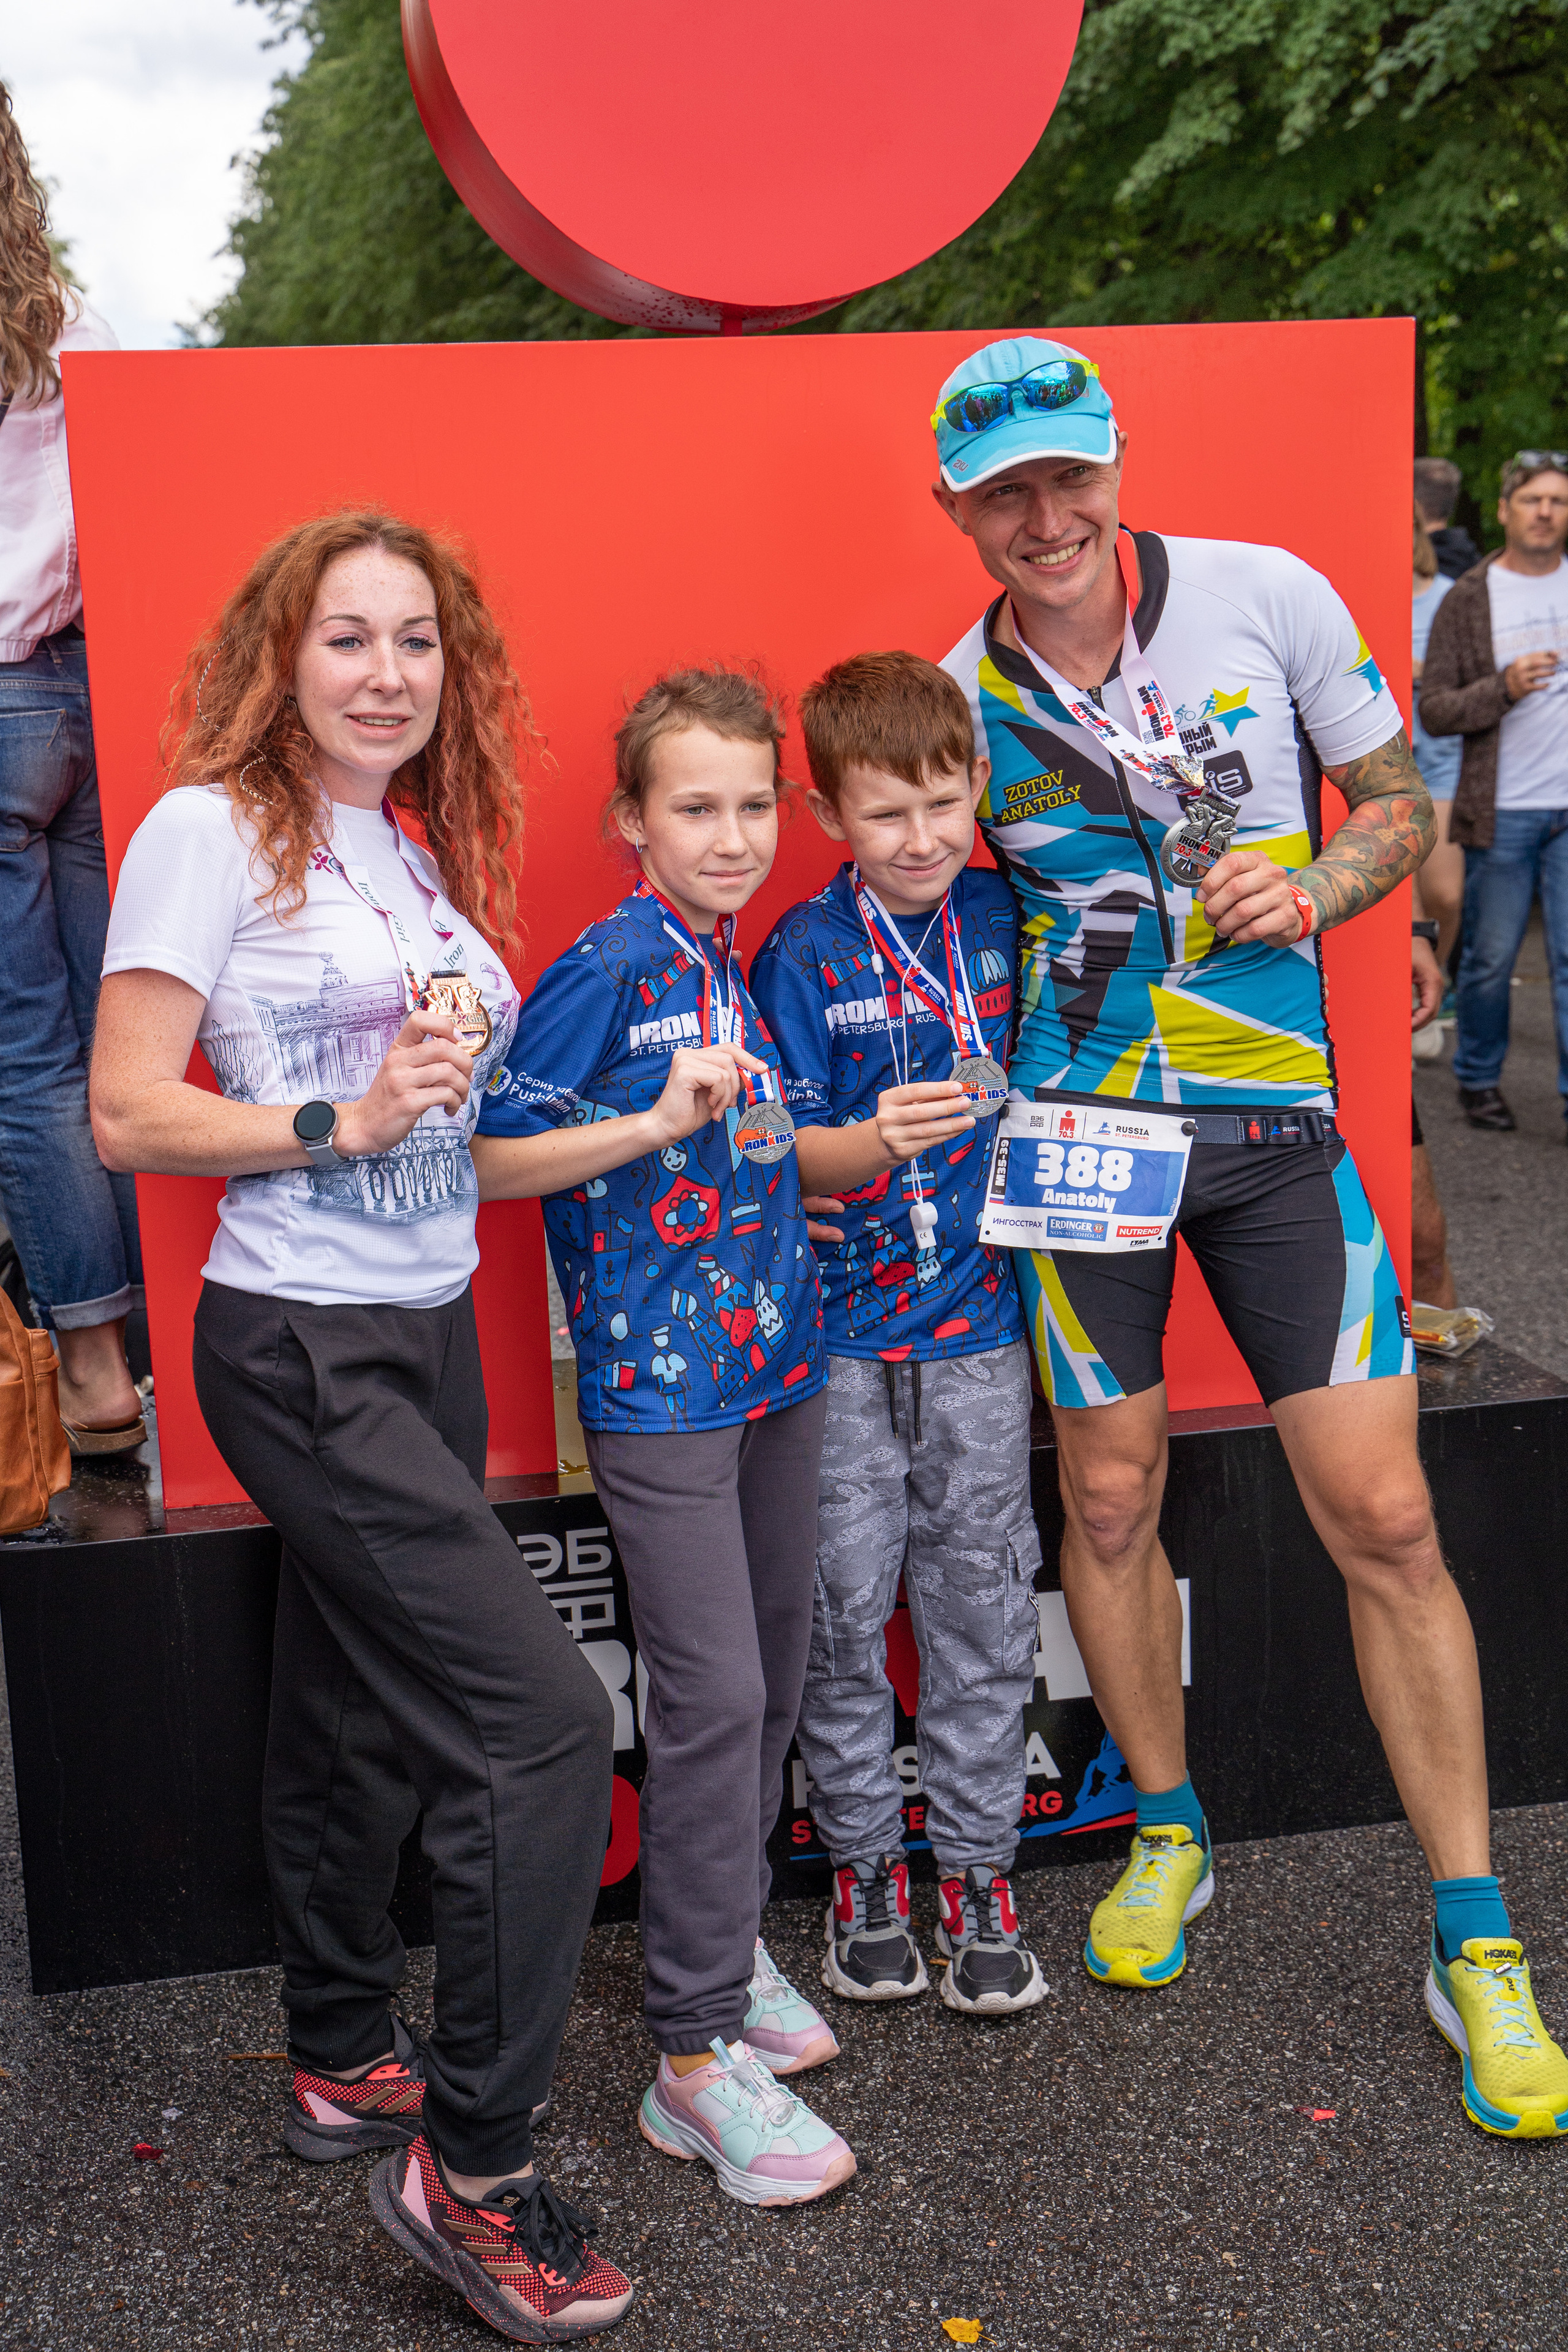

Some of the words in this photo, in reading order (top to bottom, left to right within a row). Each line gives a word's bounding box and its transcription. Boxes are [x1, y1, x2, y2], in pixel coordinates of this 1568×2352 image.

[953, 459, 968, 472] 2XU
[1137, 685, 1165, 742] IRONMAN
[1152, 692, 1165, 715] RUSSIA
[1067, 703, 1087, 720] 70.3
[1086, 719, 1103, 732] RUSSIA
[1076, 701, 1120, 737] IRONMAN
[1160, 714, 1175, 738] 70.3
[1183, 736, 1218, 756] РЫМ
[1005, 769, 1063, 802] ZOTOV
[1001, 784, 1081, 823] ANATOLY
[1203, 797, 1236, 816] FINISHER
[1174, 843, 1193, 857] 70.3
[1193, 851, 1210, 862] RUSSIA
[1178, 834, 1222, 861] IRONMAN
[357, 881, 380, 906] Iron
[393, 914, 410, 943] Girl
[443, 943, 464, 969] Iron
[928, 987, 941, 1002] RUSSIA
[466, 1012, 485, 1023] Girl
[731, 979, 742, 1049] RONKIDS
[954, 989, 973, 1042] IRONKIDS
[839, 1018, 905, 1035] PETERSBURG
[630, 1046, 646, 1057] ST.
[649, 1037, 703, 1055] PETERSBU
[518, 1072, 554, 1091] Серия
[741, 1132, 794, 1152] RONKIDS
[1115, 1125, 1150, 1136] RUSSIA
[995, 1139, 1009, 1187] M35-39
[1034, 1142, 1134, 1192] 388
[1041, 1188, 1117, 1214] Anatoly
[992, 1217, 1042, 1228] ИНГОССТРАХ
[1050, 1219, 1093, 1232] ERDINGER
[1118, 1227, 1161, 1236] NUTREND
[1049, 1230, 1104, 1239] NON-ALCOHOLIC
[517, 1527, 611, 1578] ЭБ
